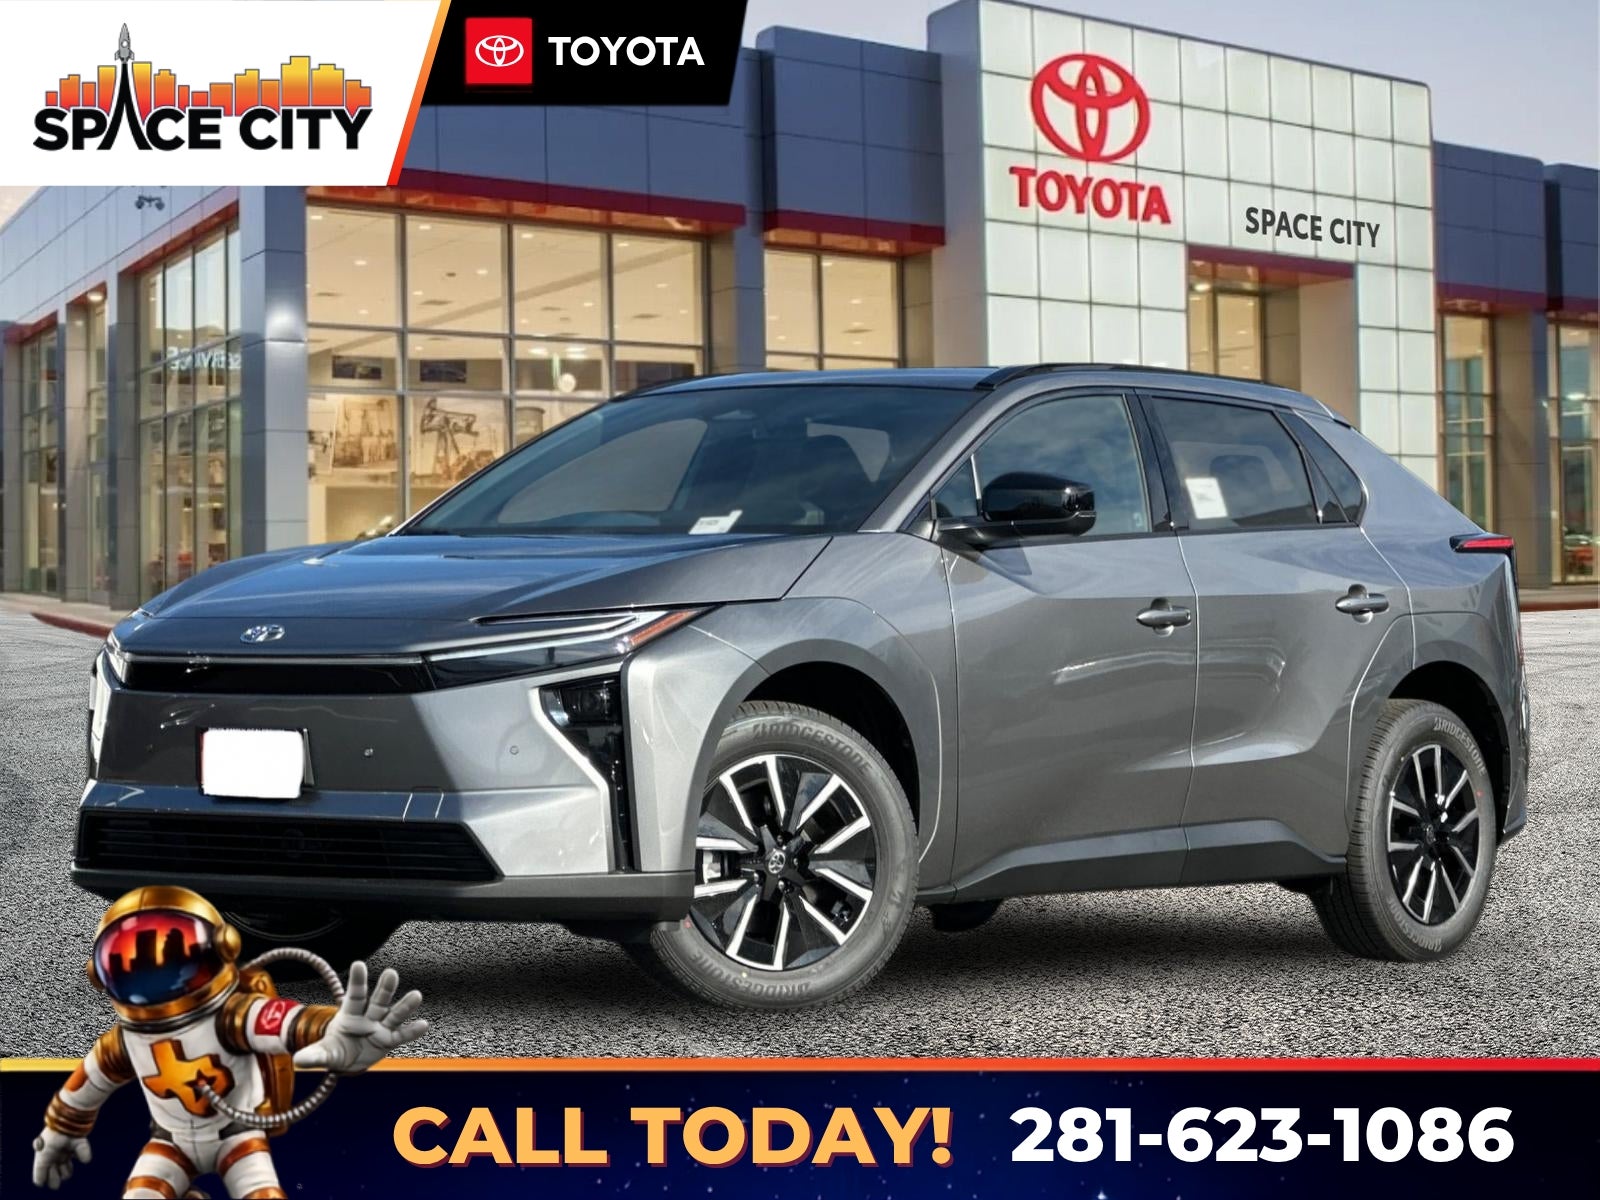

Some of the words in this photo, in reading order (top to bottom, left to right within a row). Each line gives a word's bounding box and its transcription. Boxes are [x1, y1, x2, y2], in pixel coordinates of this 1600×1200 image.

[1009, 166, 1172, 224] TOYOTA
[1245, 207, 1323, 242] SPACE
[1329, 217, 1381, 248] CITY
